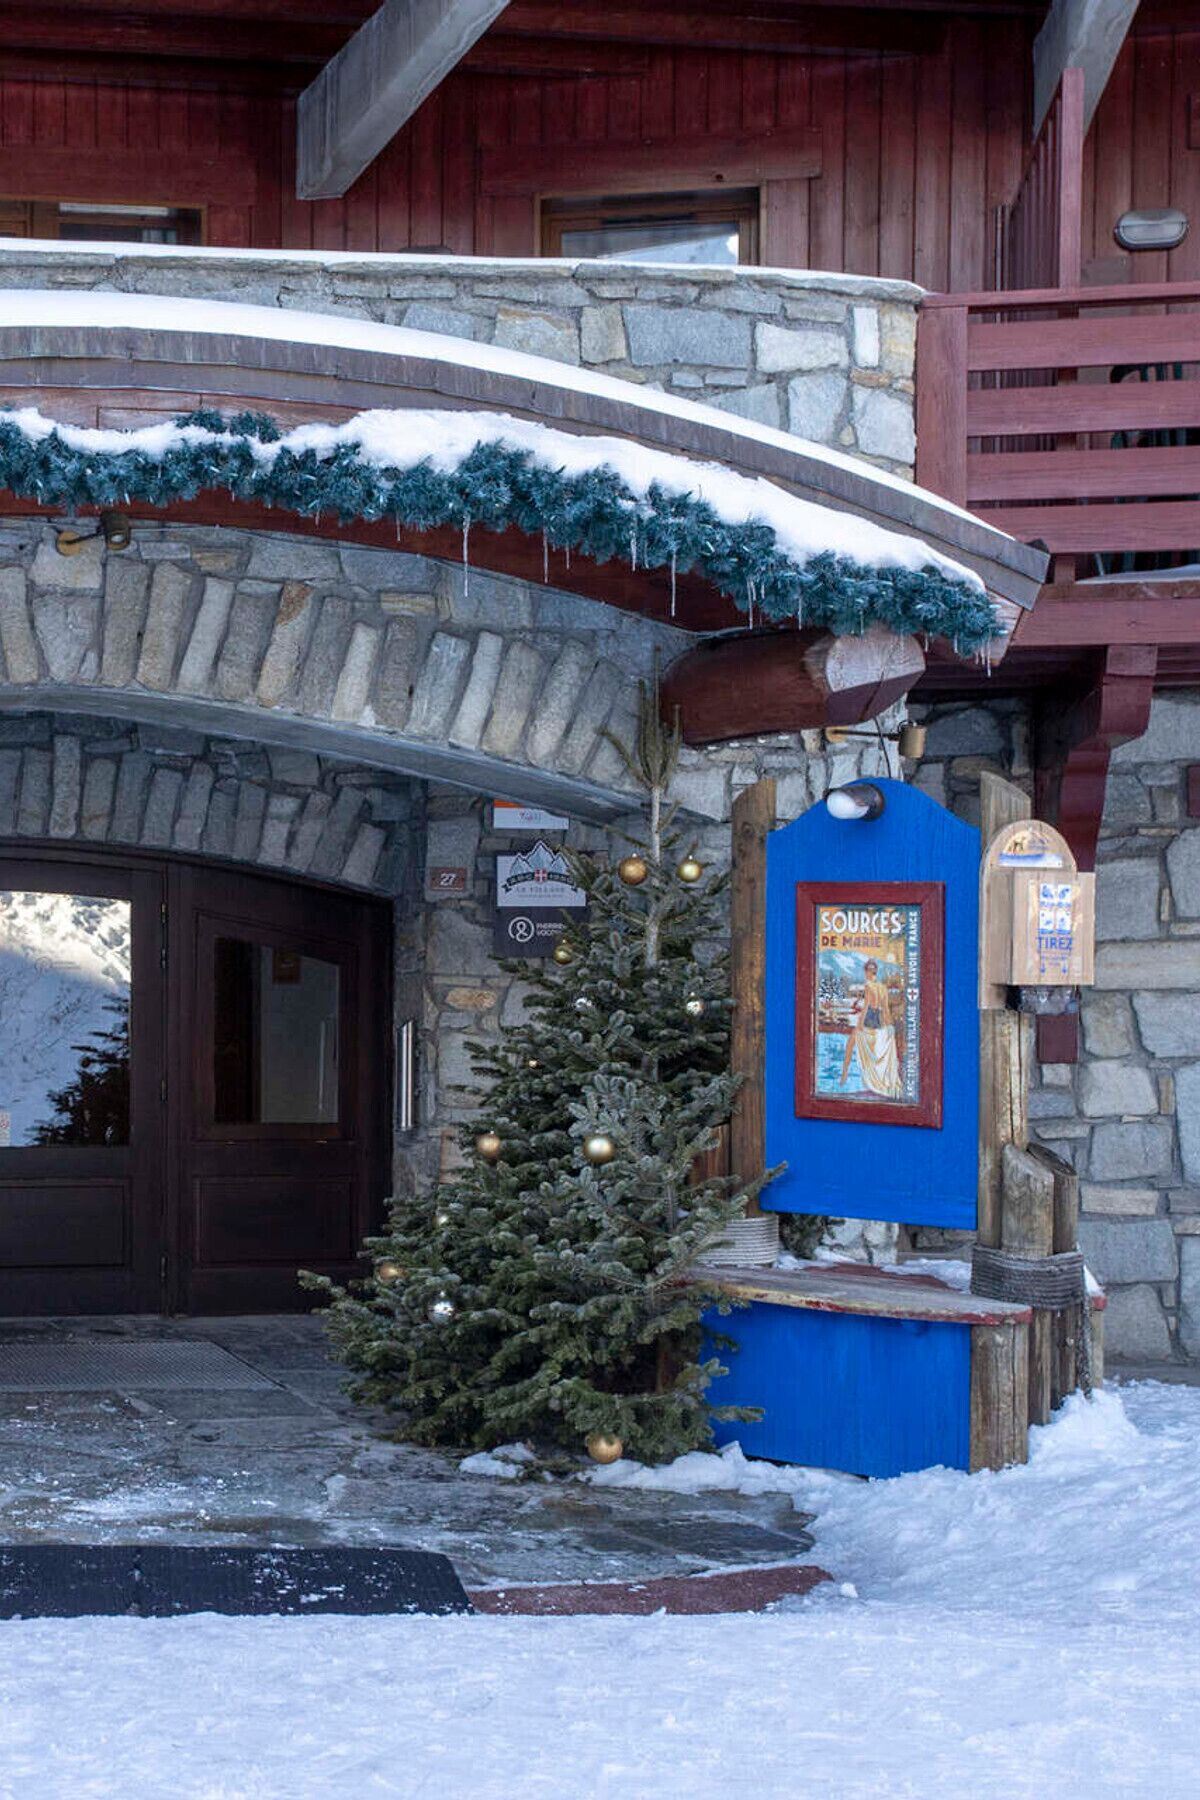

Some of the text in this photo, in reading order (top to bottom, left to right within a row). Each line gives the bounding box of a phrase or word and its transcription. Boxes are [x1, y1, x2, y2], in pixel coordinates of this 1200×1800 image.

[440, 872, 456, 886] 27
[820, 911, 902, 933] SOURCES
[908, 911, 918, 946] FRANCE
[821, 935, 881, 947] DE MARIE
[1037, 937, 1073, 950] TIREZ
[908, 951, 918, 984] SAVOIE
[906, 1005, 917, 1040] VILLAGE
